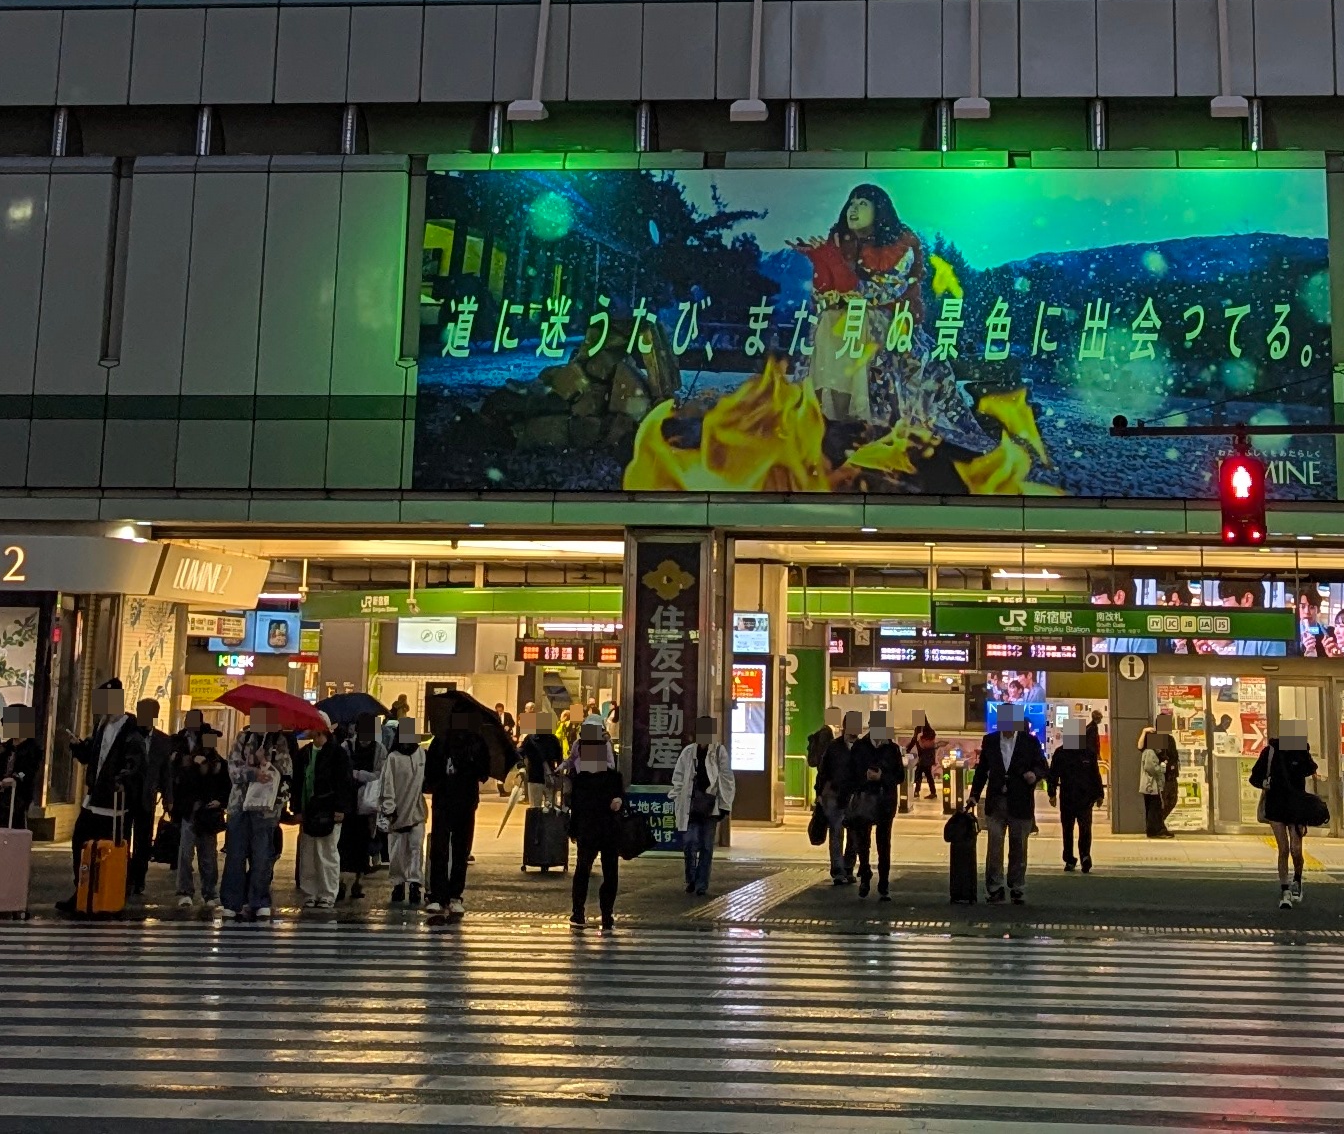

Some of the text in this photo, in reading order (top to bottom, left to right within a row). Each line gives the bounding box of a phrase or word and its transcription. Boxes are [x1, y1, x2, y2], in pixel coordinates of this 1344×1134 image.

[1217, 460, 1322, 485] MINE
[3, 546, 26, 581] 2
[173, 557, 223, 593] LUMINE
[999, 609, 1124, 626] JR 新宿駅 南改札
[1033, 625, 1064, 635] Shinjuku
[1066, 625, 1091, 634] Station
[218, 653, 254, 667] KIOSK
[648, 605, 685, 769] 住友不動産
